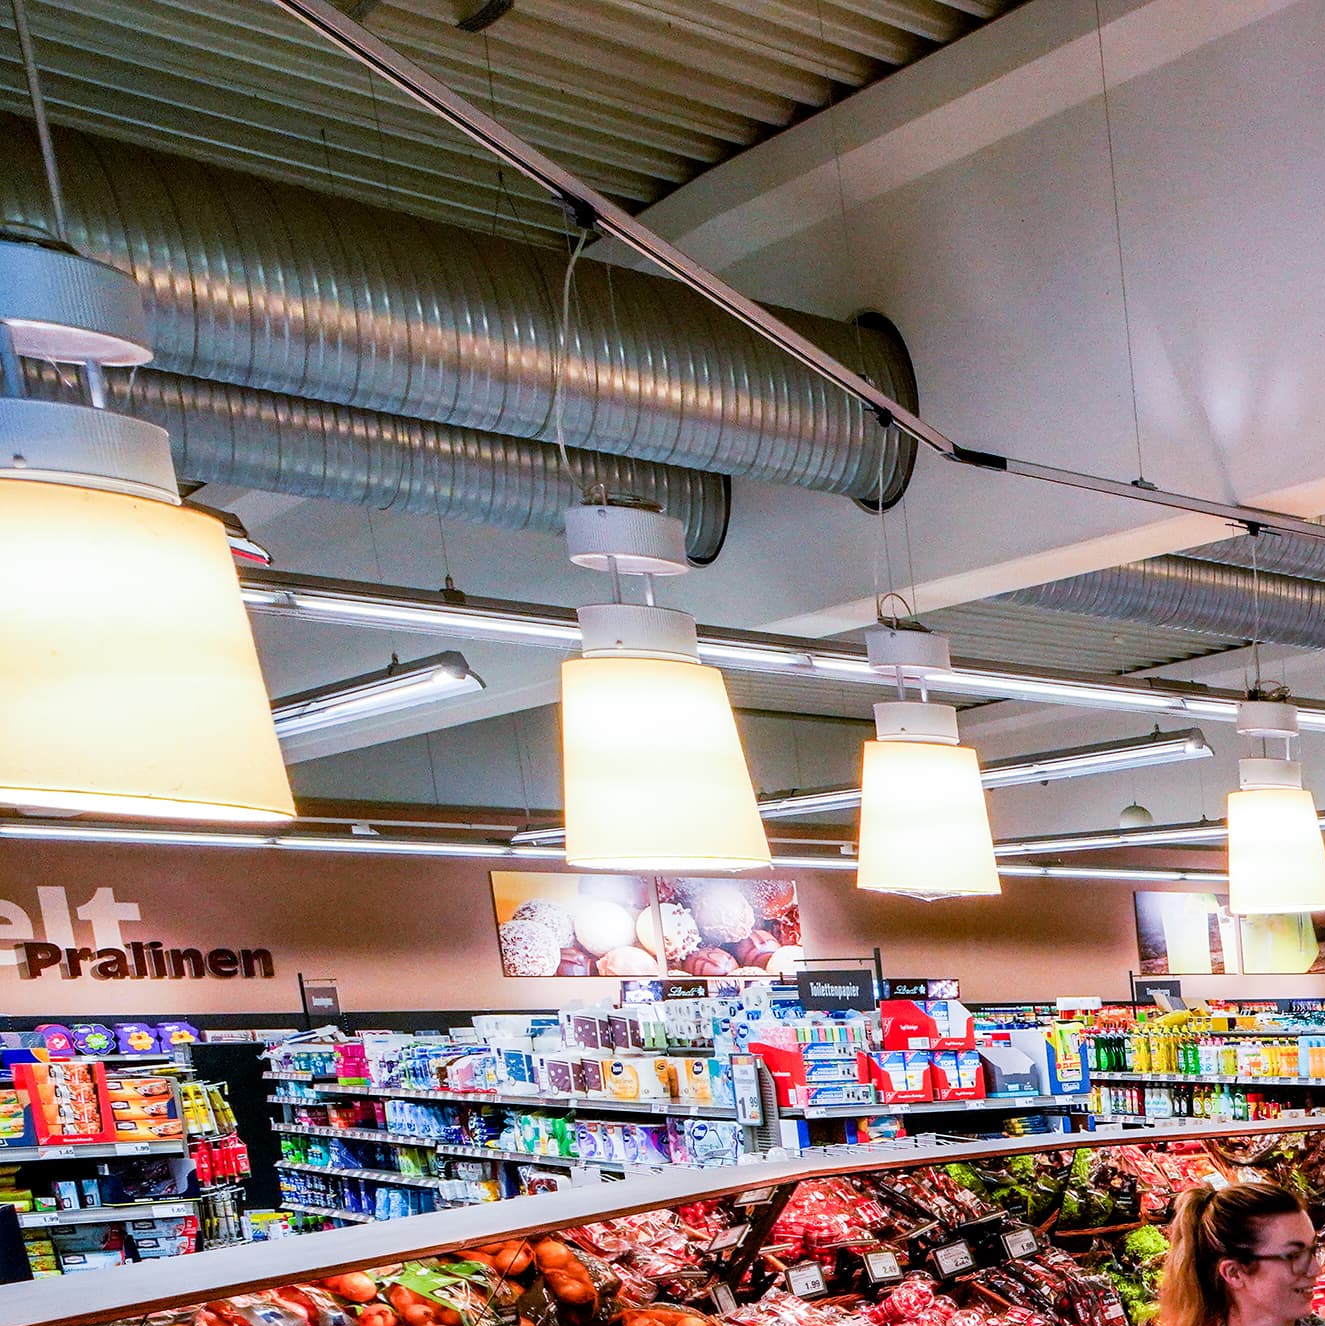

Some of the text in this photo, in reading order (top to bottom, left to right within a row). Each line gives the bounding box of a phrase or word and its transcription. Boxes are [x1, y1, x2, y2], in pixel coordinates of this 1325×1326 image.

[18, 941, 275, 979] Pralinen
[809, 982, 859, 1000] Toilettenpapier
[805, 1279, 821, 1290] 1.99
